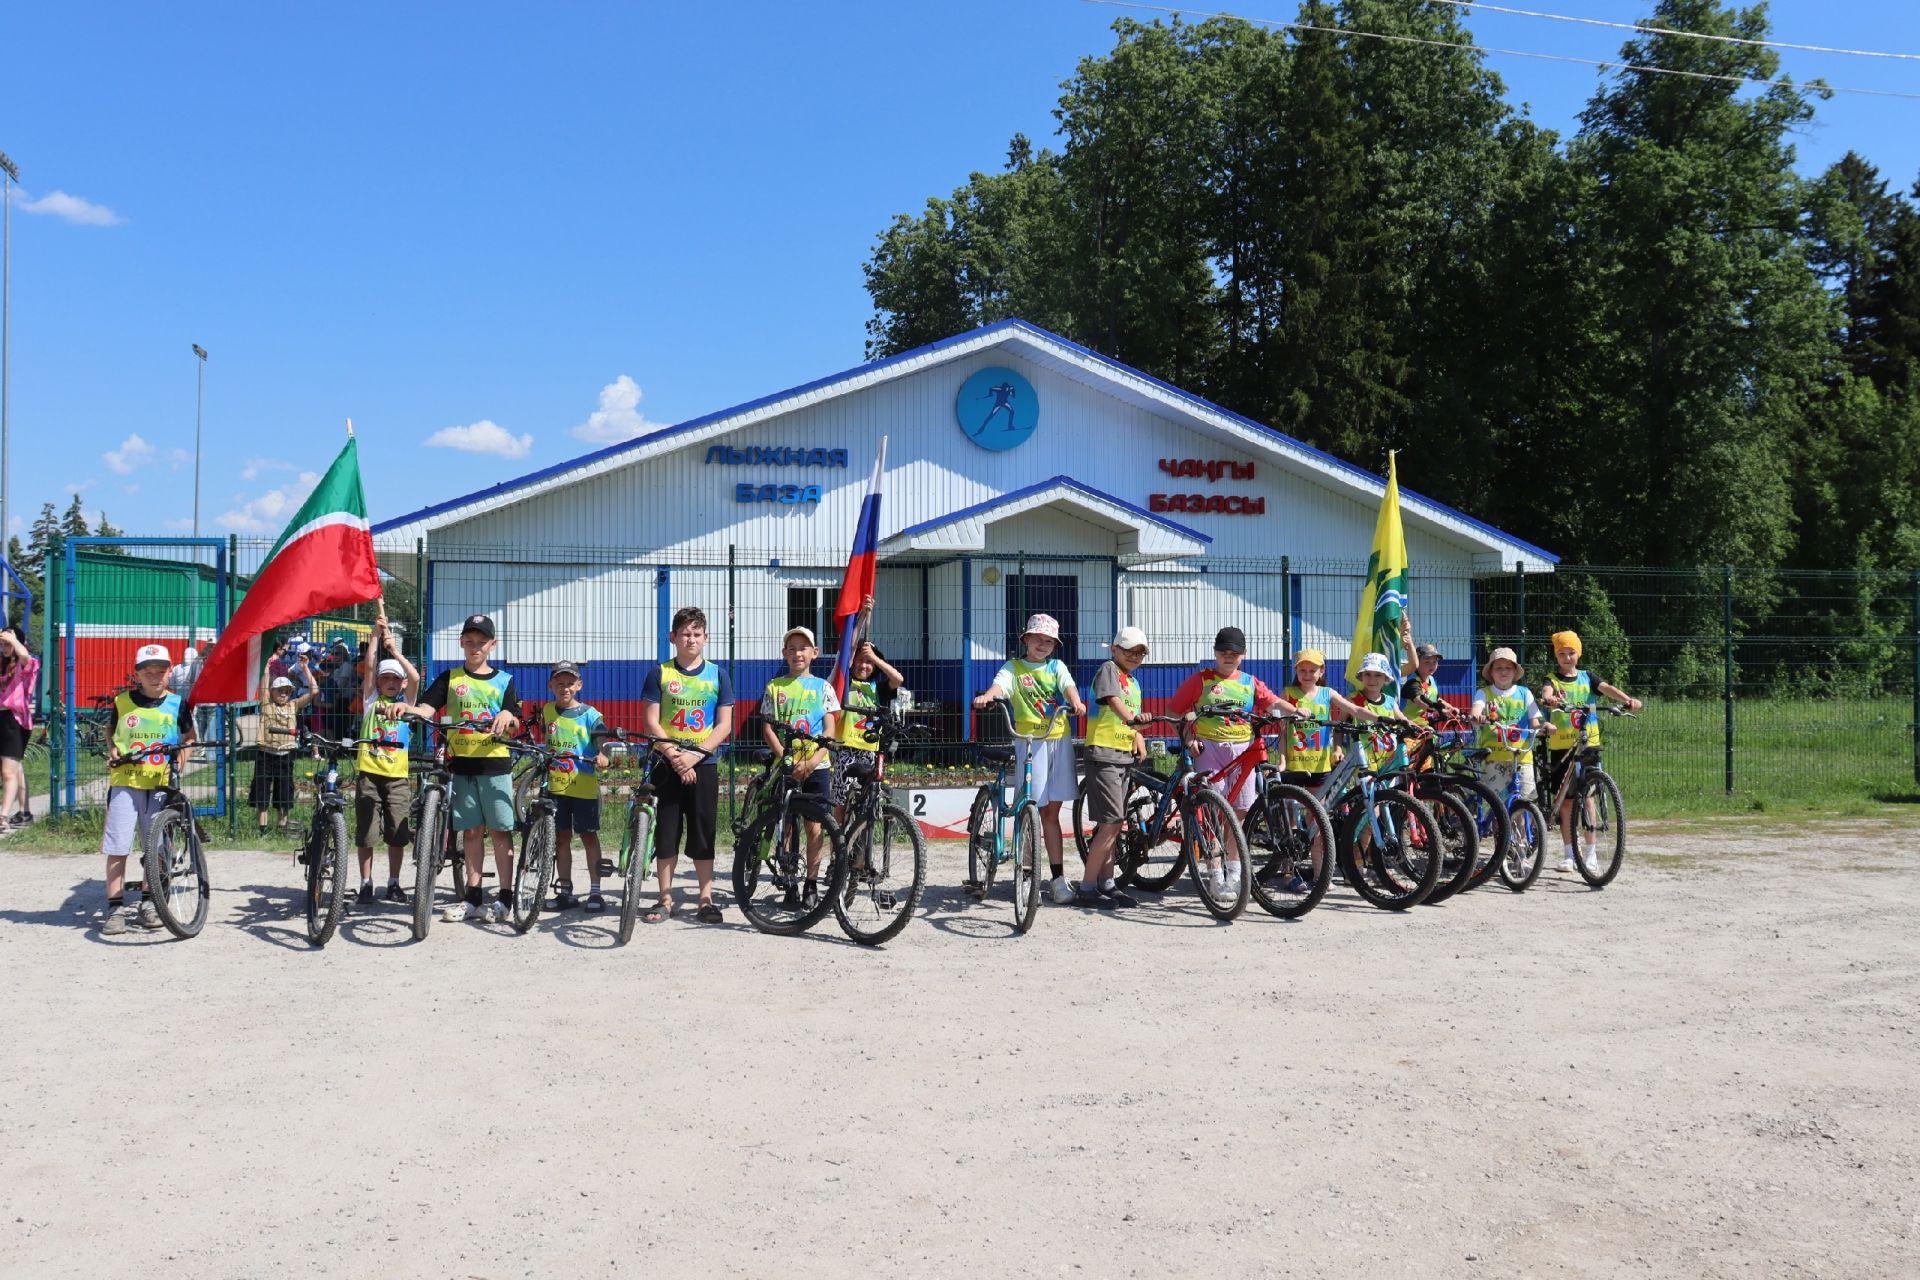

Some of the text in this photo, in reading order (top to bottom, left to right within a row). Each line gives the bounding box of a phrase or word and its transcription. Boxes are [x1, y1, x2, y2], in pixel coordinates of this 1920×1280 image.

[705, 445, 849, 468] ЛЫЖНАЯ
[735, 482, 822, 504] БАЗА
[1149, 494, 1265, 515] БАЗАСЫ
[670, 708, 706, 733] 43
[1293, 730, 1321, 751] 31
[913, 794, 927, 816] 2
